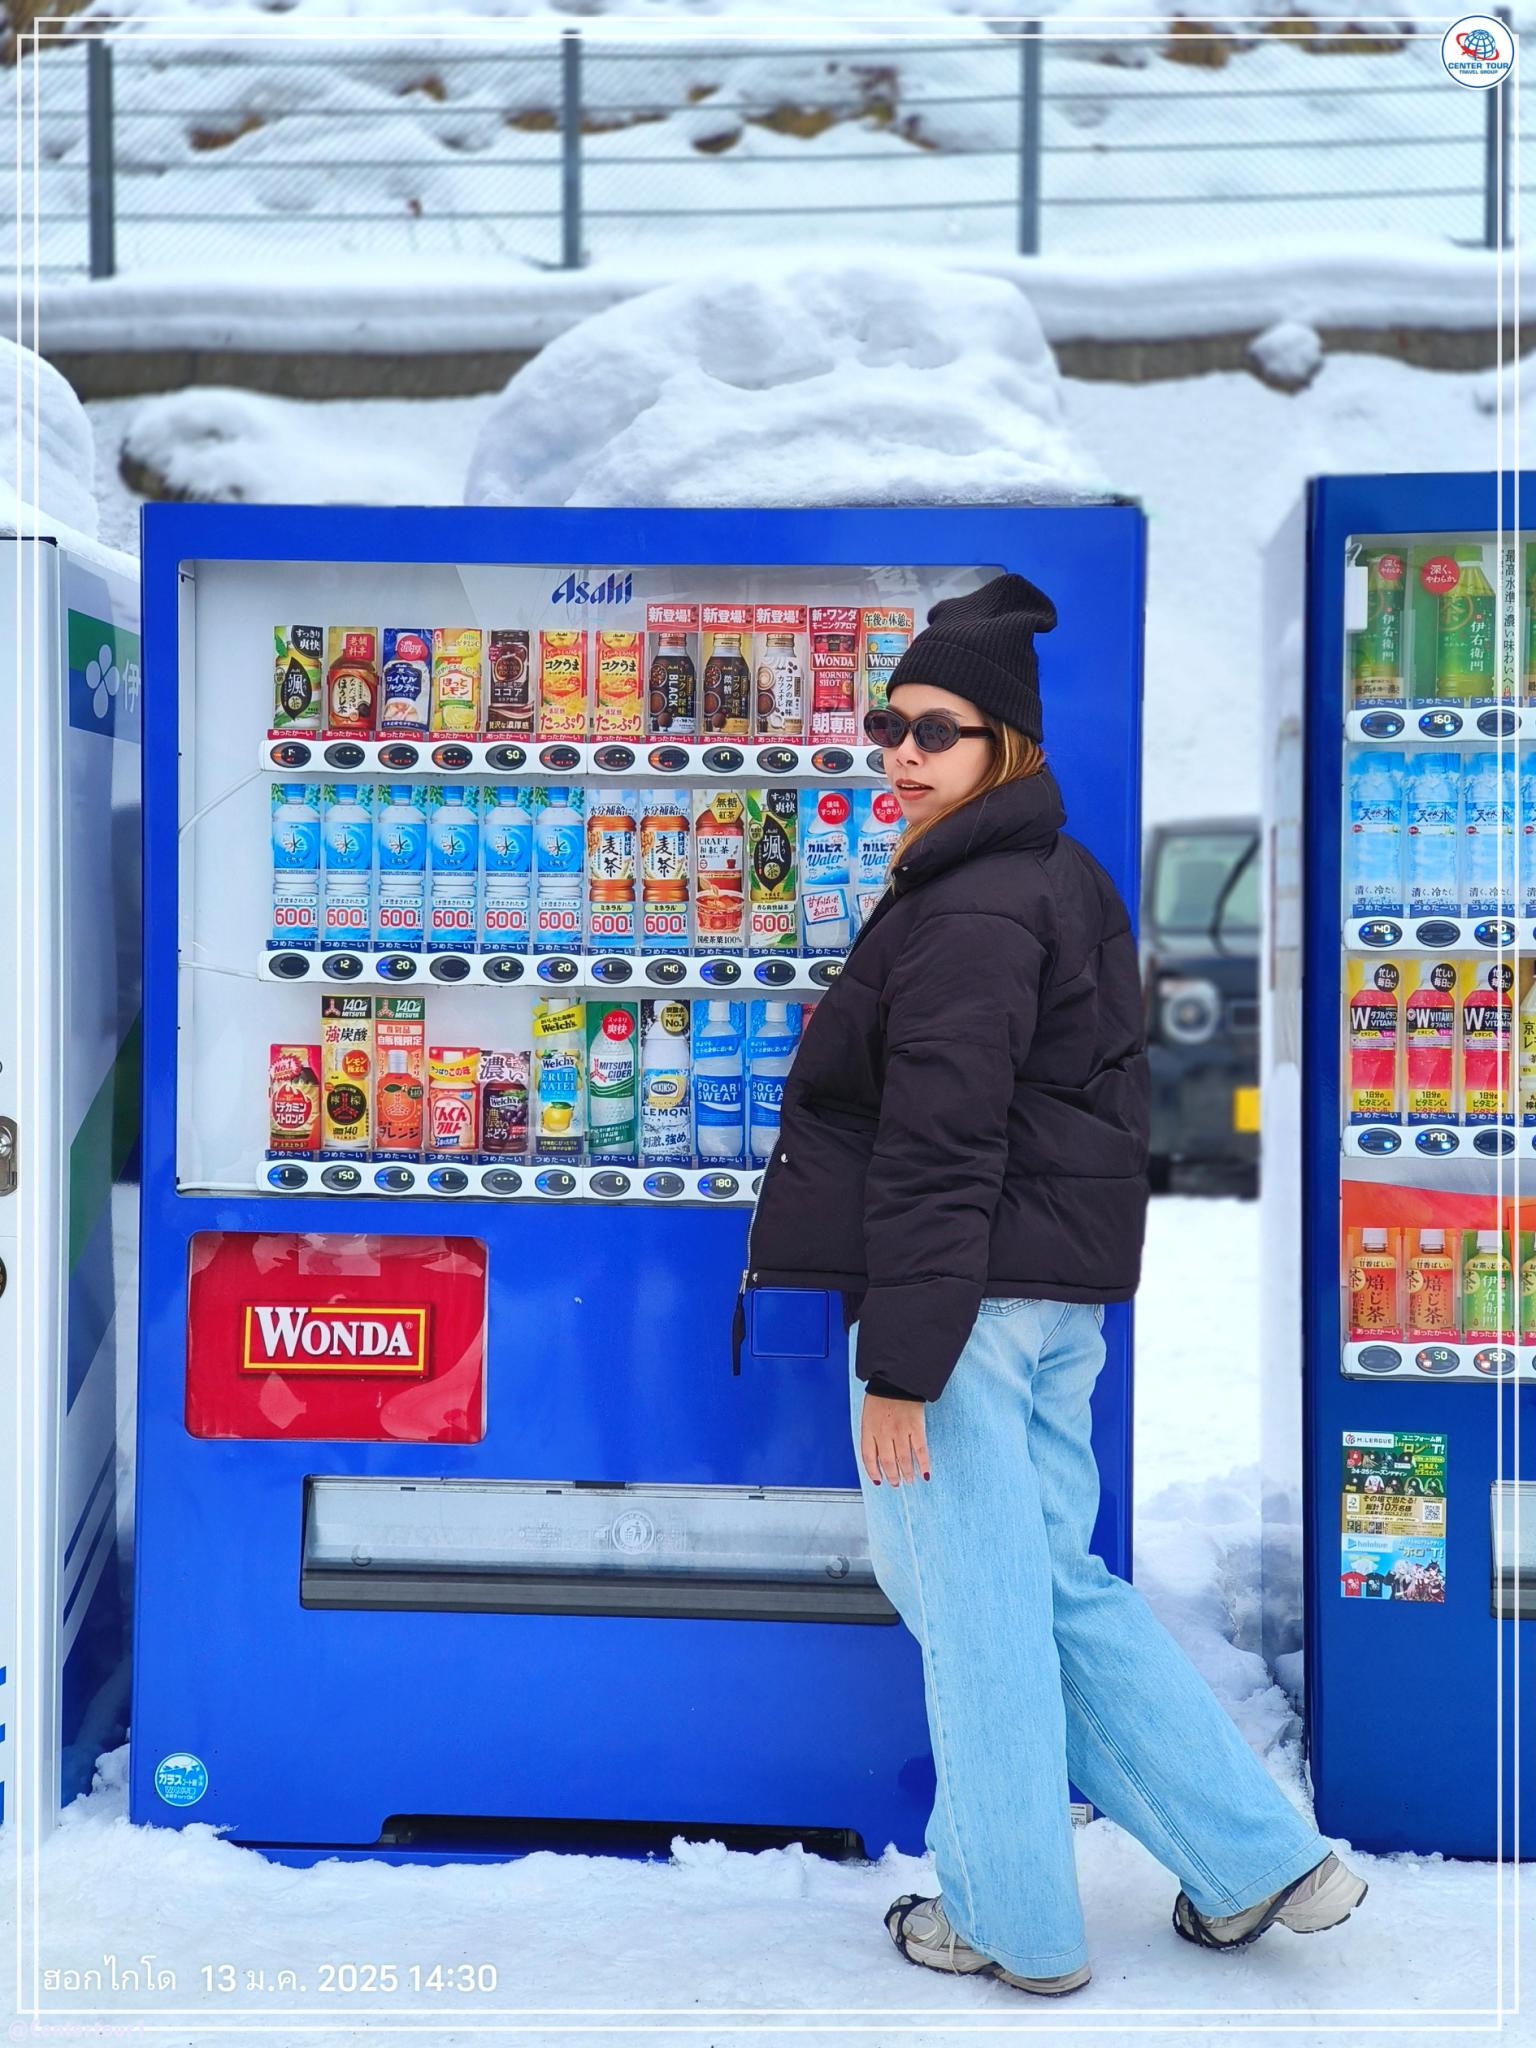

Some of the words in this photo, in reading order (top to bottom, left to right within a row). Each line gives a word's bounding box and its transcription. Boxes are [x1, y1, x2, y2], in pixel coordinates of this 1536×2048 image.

[552, 573, 632, 604] Asahi
[649, 607, 691, 623] 新登場!
[703, 608, 745, 623] 新登場!
[757, 608, 799, 624] 新登場!
[813, 609, 857, 621] 新・ワンダ
[296, 629, 320, 638] すっきり
[300, 640, 320, 650] 爽快
[1470, 621, 1486, 671] 伊右衛門
[545, 660, 580, 671] コクうま
[602, 660, 636, 672] コクうま
[814, 654, 854, 667] WONDA
[387, 675, 417, 683] ロイヤル
[443, 678, 468, 686] ほっと
[338, 679, 347, 713] ほうじ茶
[442, 688, 469, 696] レモン
[494, 688, 523, 697] ココア
[669, 674, 678, 706] BLACK
[540, 715, 585, 730] たっぷり
[596, 715, 641, 731] たっぷり
[813, 713, 855, 734] 朝専用
[771, 792, 796, 800] すっきり
[716, 798, 737, 807] 無糖
[775, 803, 795, 813] 爽快
[718, 811, 735, 819] 紅茶
[1418, 809, 1450, 822] 天然水
[808, 843, 841, 852] カルピス
[602, 835, 621, 878] 麦茶
[656, 835, 675, 878] 麦茶
[807, 854, 843, 866] Water
[276, 908, 311, 925] 600
[327, 909, 362, 926] 600
[381, 910, 415, 927] 600
[433, 911, 468, 927] 600
[486, 911, 522, 928] 600
[539, 912, 574, 929] 600
[592, 915, 628, 933] 600
[645, 915, 681, 933] 600
[753, 915, 789, 932] 600
[1378, 969, 1396, 978] 忙しい
[1435, 969, 1453, 978] 忙しい
[541, 1021, 577, 1033] Welch's
[607, 1024, 627, 1034] 爽快
[666, 1019, 684, 1027] No.1
[326, 1026, 368, 1042] 強炭酸
[345, 1057, 368, 1065] レモン
[543, 1058, 574, 1068] Welch's
[599, 1060, 632, 1069] MITSUYA
[608, 1069, 632, 1078] CIDER
[698, 1084, 740, 1092] POCARI
[698, 1093, 737, 1101] SWEAT
[275, 1102, 306, 1112] ドデカミン
[643, 1108, 688, 1117] LEMON
[276, 1114, 304, 1124] ストロング
[485, 1129, 507, 1139] ぶどう
[1366, 1276, 1385, 1323] 焙じ茶
[1423, 1276, 1443, 1323] 焙じ茶
[255, 1307, 412, 1357] WONDA
